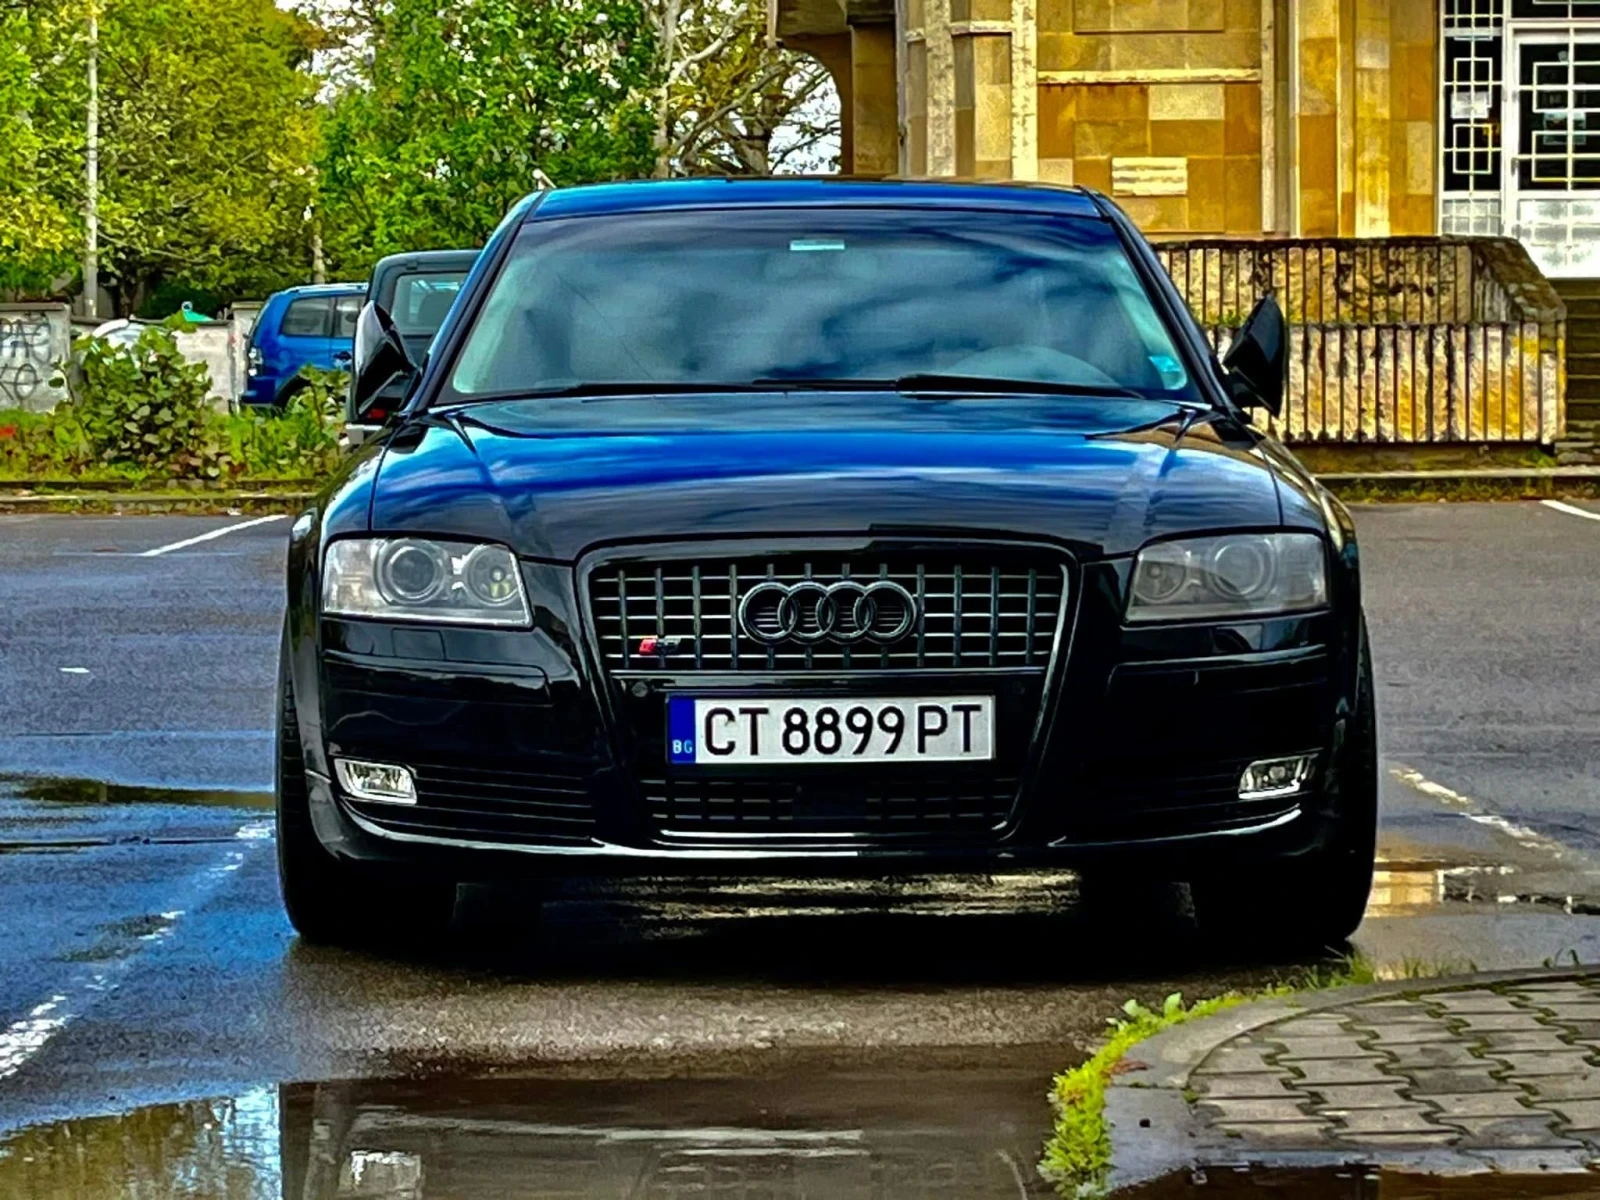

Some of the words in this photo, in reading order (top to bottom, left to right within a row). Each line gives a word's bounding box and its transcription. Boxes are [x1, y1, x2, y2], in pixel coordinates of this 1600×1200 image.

[704, 707, 770, 756] CT
[782, 706, 905, 756] 8899
[917, 704, 982, 754] PT
[673, 740, 693, 754] BG
